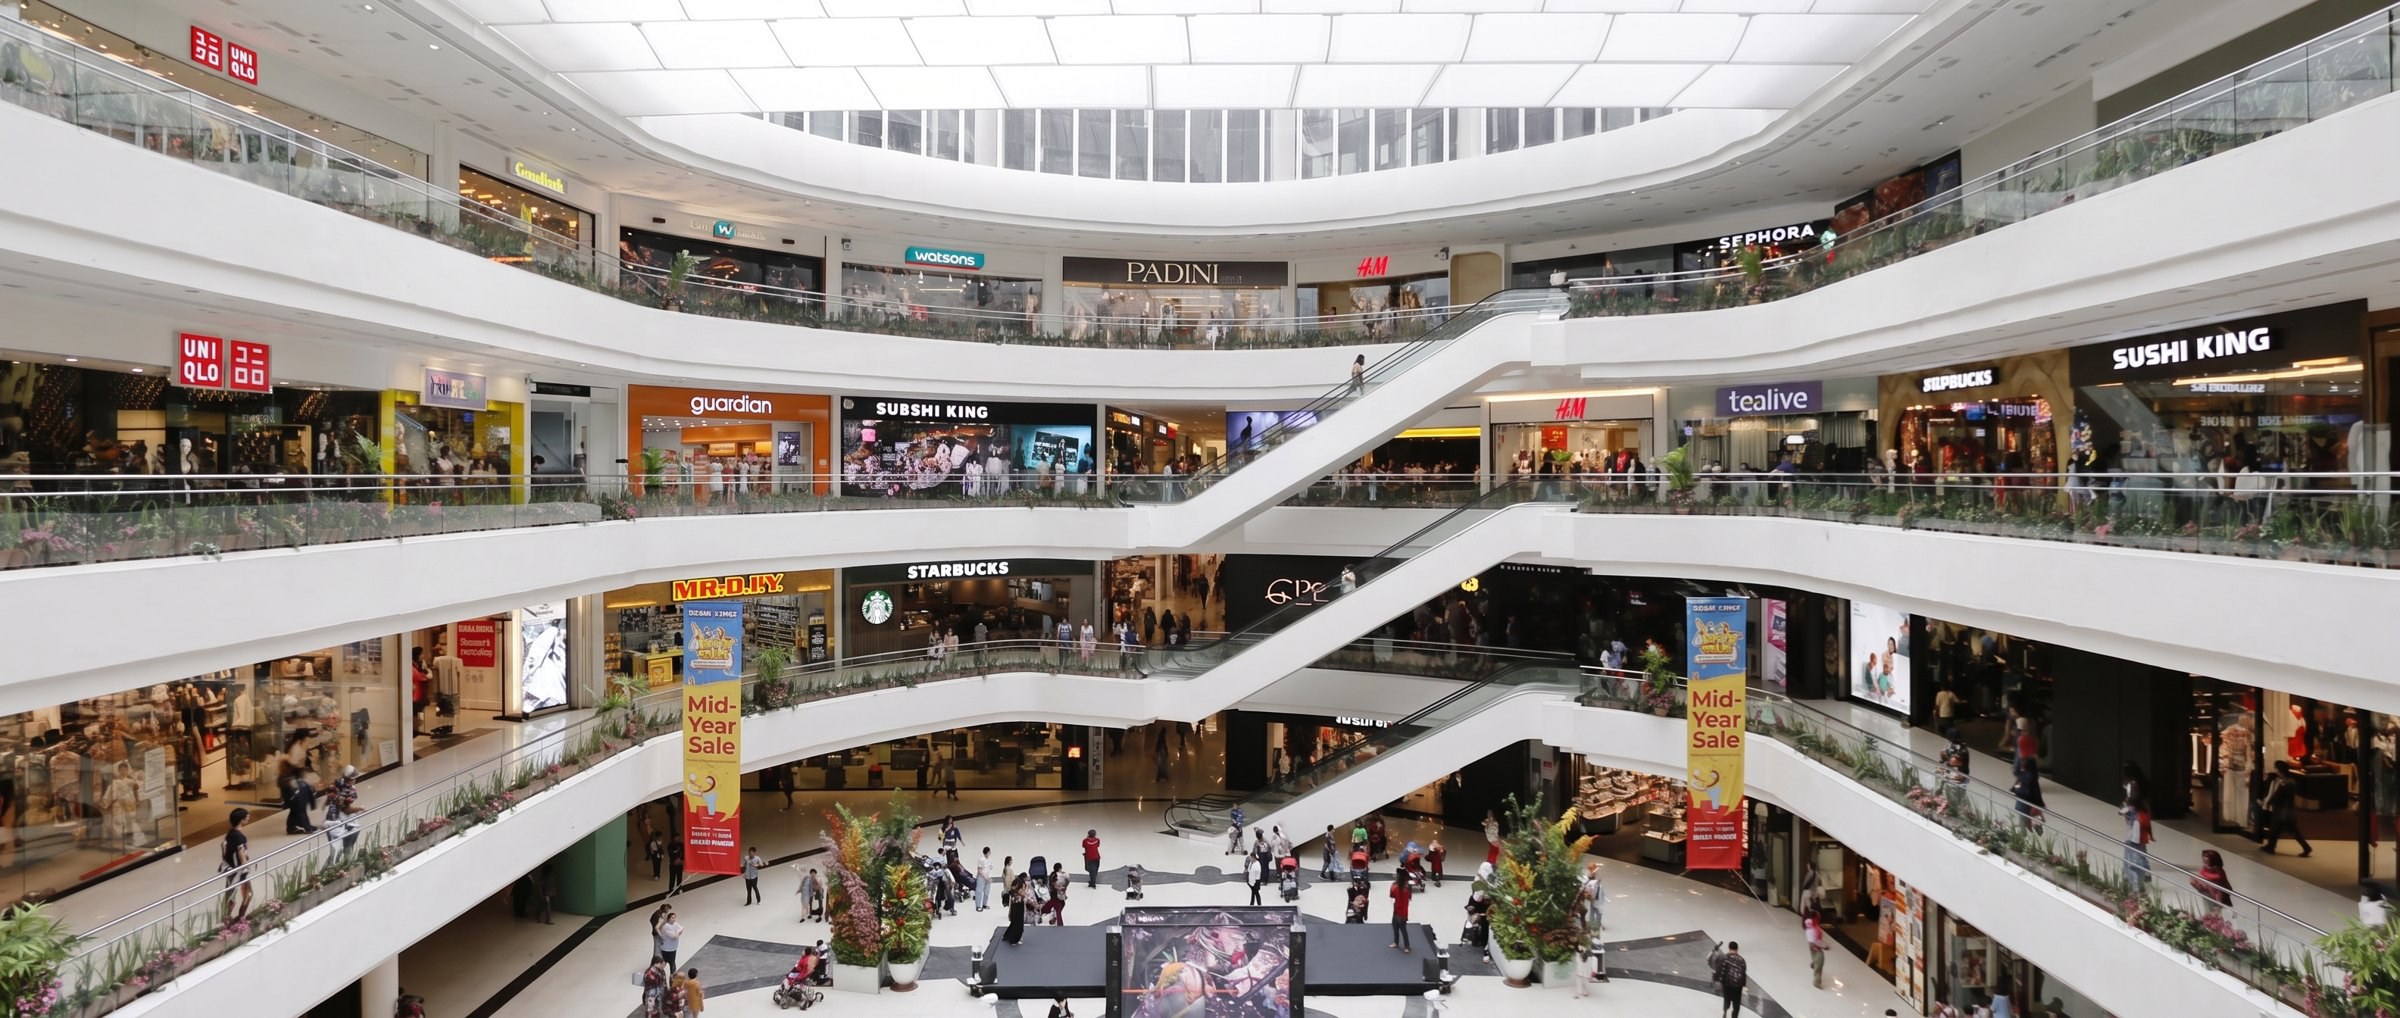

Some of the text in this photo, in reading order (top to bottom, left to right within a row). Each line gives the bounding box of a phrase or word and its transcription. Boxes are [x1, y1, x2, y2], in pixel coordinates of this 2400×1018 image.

[230, 46, 253, 66] UNI
[231, 61, 255, 80] QLO
[1719, 224, 1815, 249] SEPHORA
[915, 251, 976, 266] watsons
[1126, 262, 1219, 284] PADINI
[184, 338, 216, 360] UNI
[2112, 327, 2271, 370] SUSHI KING
[183, 361, 219, 383] QLO
[690, 394, 772, 415] guardian
[1728, 388, 1808, 412] tealive
[876, 402, 989, 419] SUBSHI KING
[907, 561, 1009, 579] STARBUCKS
[688, 694, 737, 714] Mid-
[1692, 689, 1742, 708] Mid-
[687, 715, 737, 735] Year
[1692, 711, 1742, 728] Year
[688, 736, 736, 755] Sale
[1692, 730, 1740, 748] Sale
